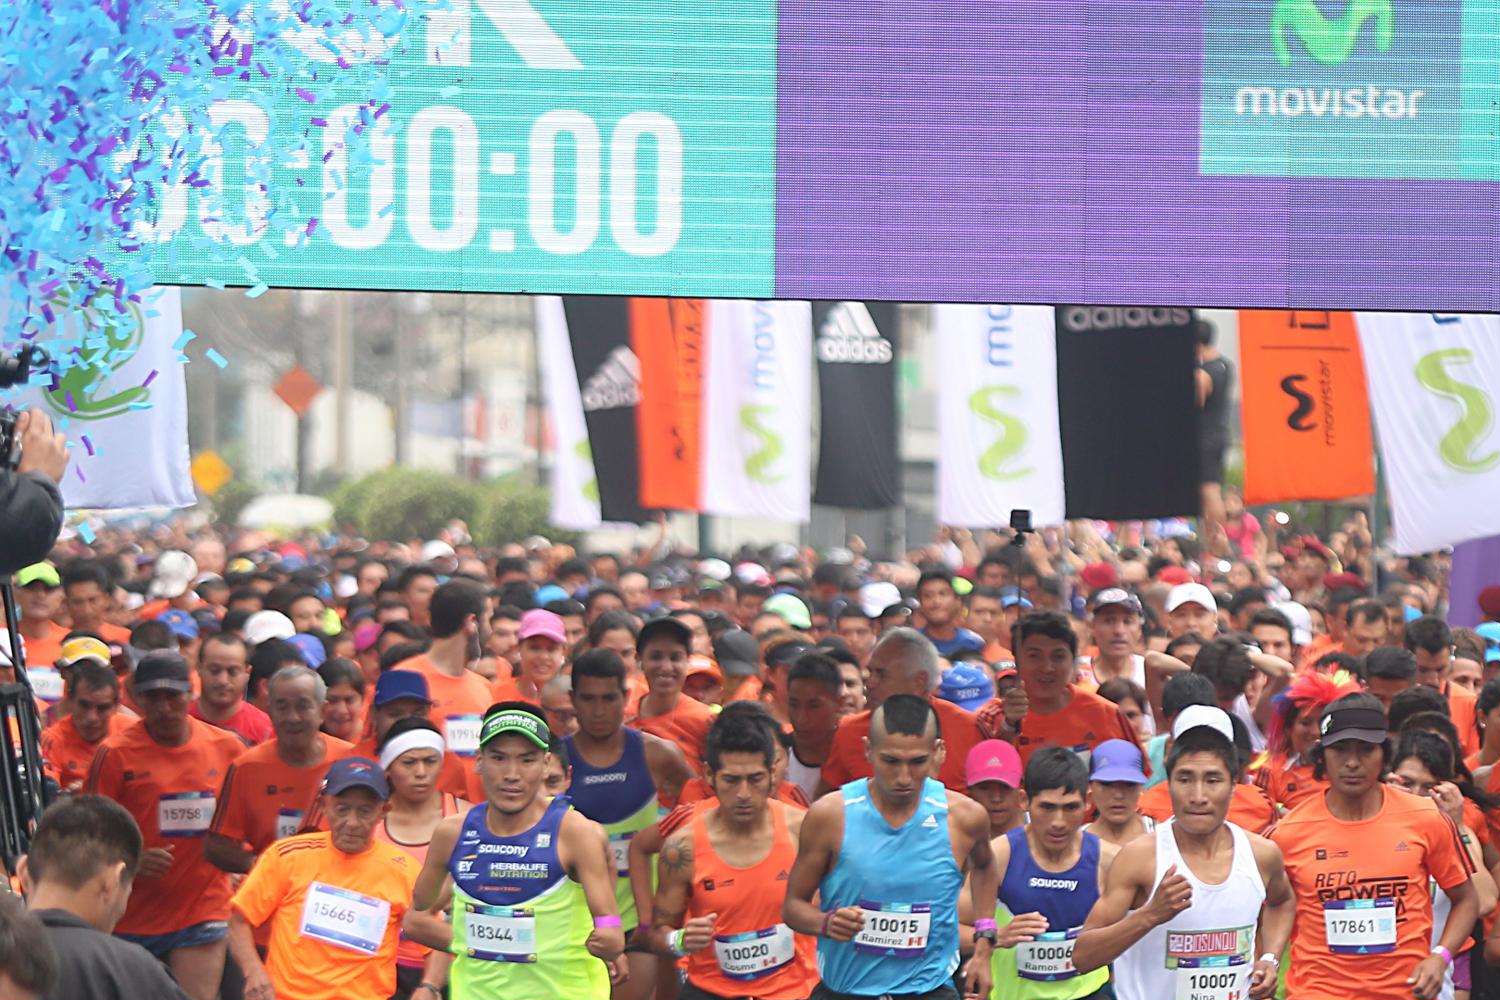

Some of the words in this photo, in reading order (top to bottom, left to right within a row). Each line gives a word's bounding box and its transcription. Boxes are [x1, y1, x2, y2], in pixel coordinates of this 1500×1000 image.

[1236, 84, 1424, 119] movistar
[816, 335, 893, 365] adidas
[584, 772, 627, 784] saucony
[478, 844, 528, 858] saucony
[458, 861, 473, 872] EY
[490, 863, 548, 871] HERBALIFE
[490, 871, 548, 879] NUTRITION
[1315, 870, 1358, 888] RETO
[1029, 877, 1078, 892] saucony
[1317, 882, 1408, 901] POWER
[313, 902, 357, 923] 15665
[470, 924, 513, 941] 18344
[870, 917, 919, 933] 10015
[1331, 919, 1375, 934] 17861
[861, 933, 903, 945] Ramirez
[724, 943, 769, 961] 10020
[1028, 945, 1073, 960] 10006
[724, 962, 757, 972] Cosme
[1024, 962, 1059, 972] Ramos
[1190, 973, 1237, 989] 10007
